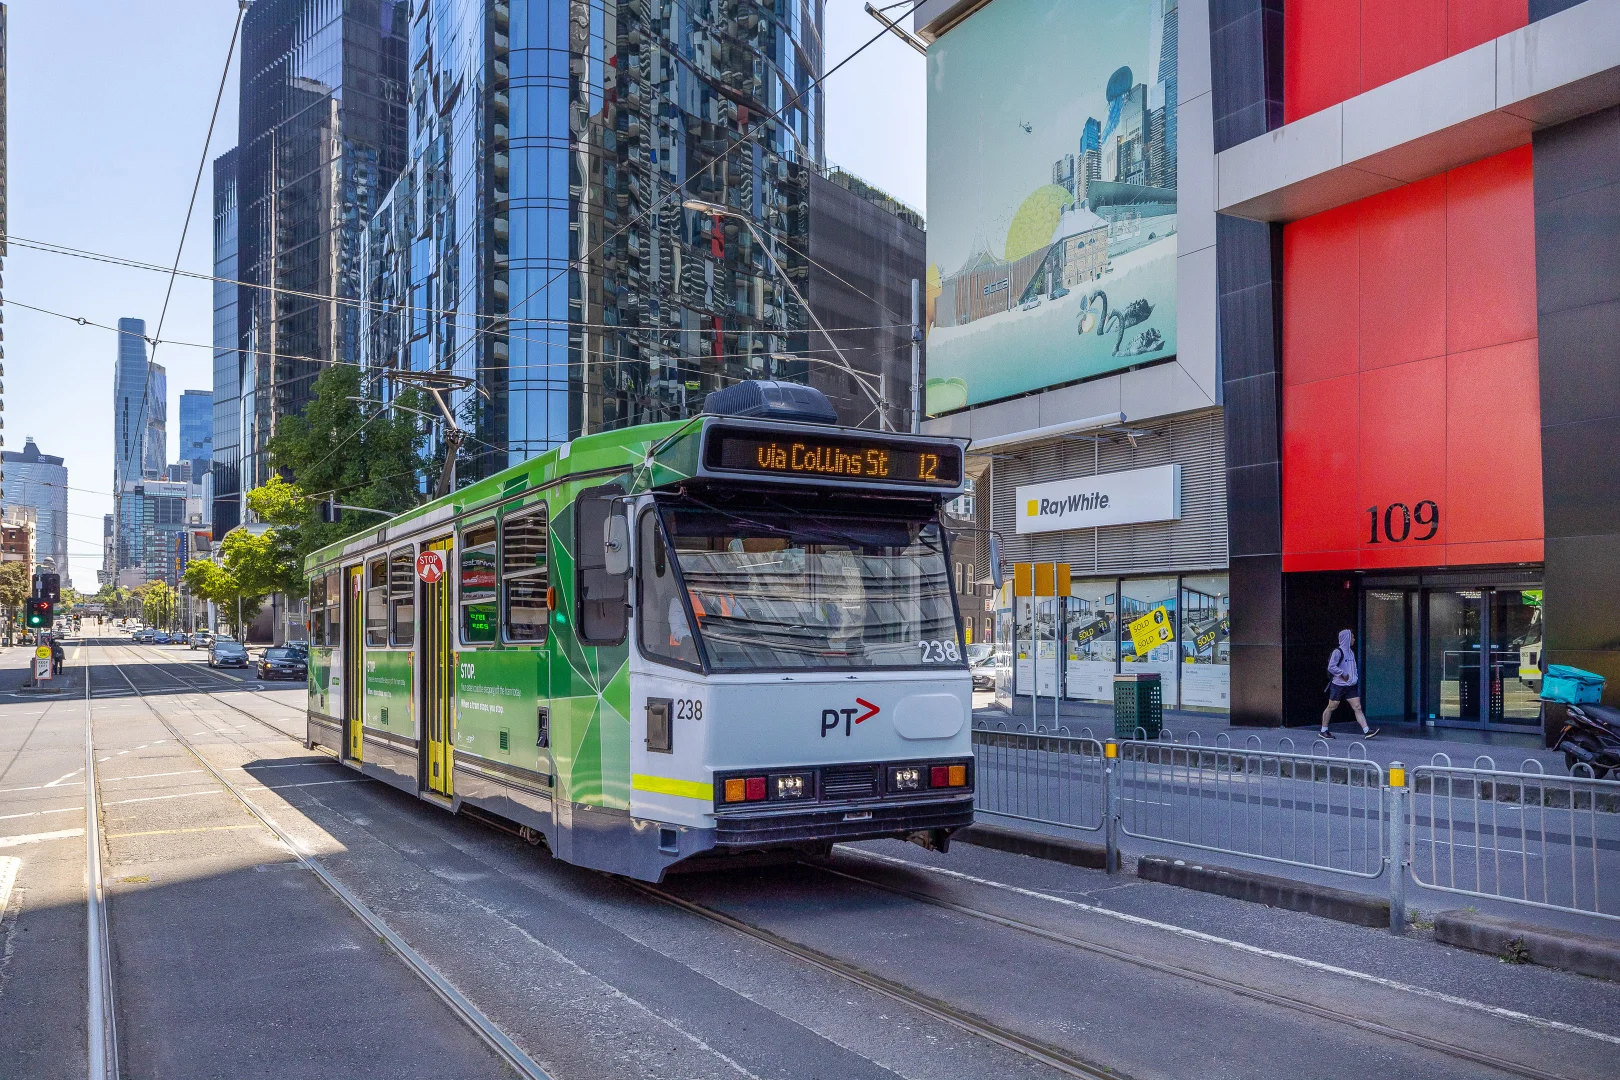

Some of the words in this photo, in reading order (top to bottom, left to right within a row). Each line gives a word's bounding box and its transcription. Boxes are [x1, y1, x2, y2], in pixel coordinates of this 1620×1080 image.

[758, 443, 787, 468] via
[791, 443, 862, 474] Collins
[866, 449, 889, 476] St
[918, 453, 937, 479] 12
[1366, 500, 1439, 543] 109
[419, 555, 438, 565] STOP
[1078, 627, 1095, 641] SOLD
[1133, 619, 1150, 633] SOLD
[1137, 635, 1155, 648] SOLD
[1197, 631, 1216, 647] SOLD
[918, 640, 960, 663] 238
[677, 699, 703, 721] 238
